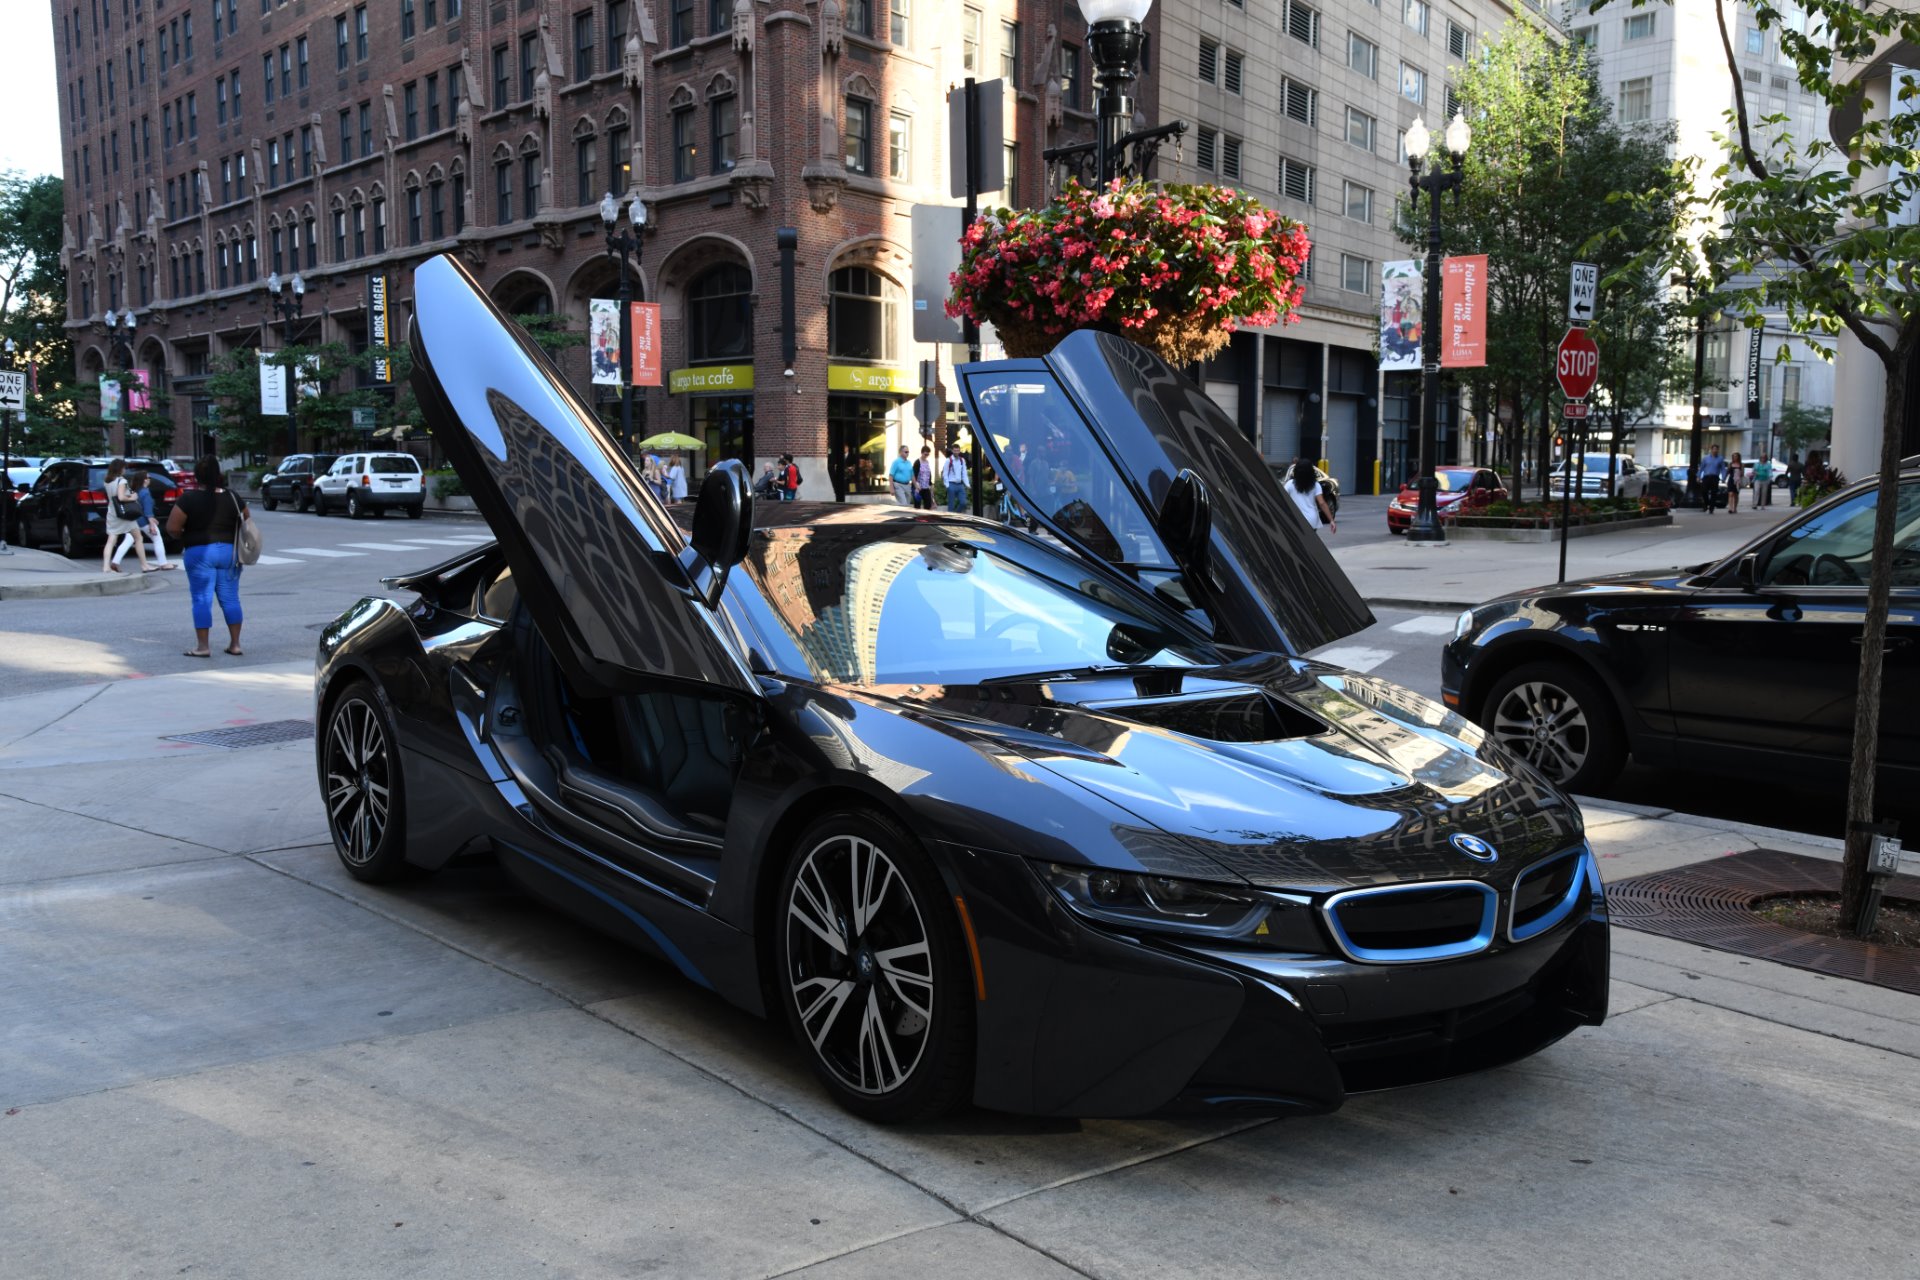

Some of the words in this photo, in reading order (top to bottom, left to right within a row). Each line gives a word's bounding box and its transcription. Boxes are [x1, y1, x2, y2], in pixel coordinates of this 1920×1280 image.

[1575, 268, 1594, 283] ONE
[373, 277, 384, 311] BAGELS
[1463, 263, 1475, 321] Following
[1574, 284, 1594, 299] WAY
[1454, 303, 1463, 321] the
[644, 307, 653, 352] Following
[1453, 324, 1463, 347] Box
[1749, 328, 1760, 377] ORDSTROM
[1560, 350, 1596, 376] STOP
[0, 374, 21, 385] ONE
[692, 374, 705, 386] tea
[708, 367, 734, 385] café
[868, 375, 892, 390] argo
[1748, 380, 1758, 402] rack
[1566, 406, 1575, 415] ALL
[1576, 406, 1585, 415] WAY
